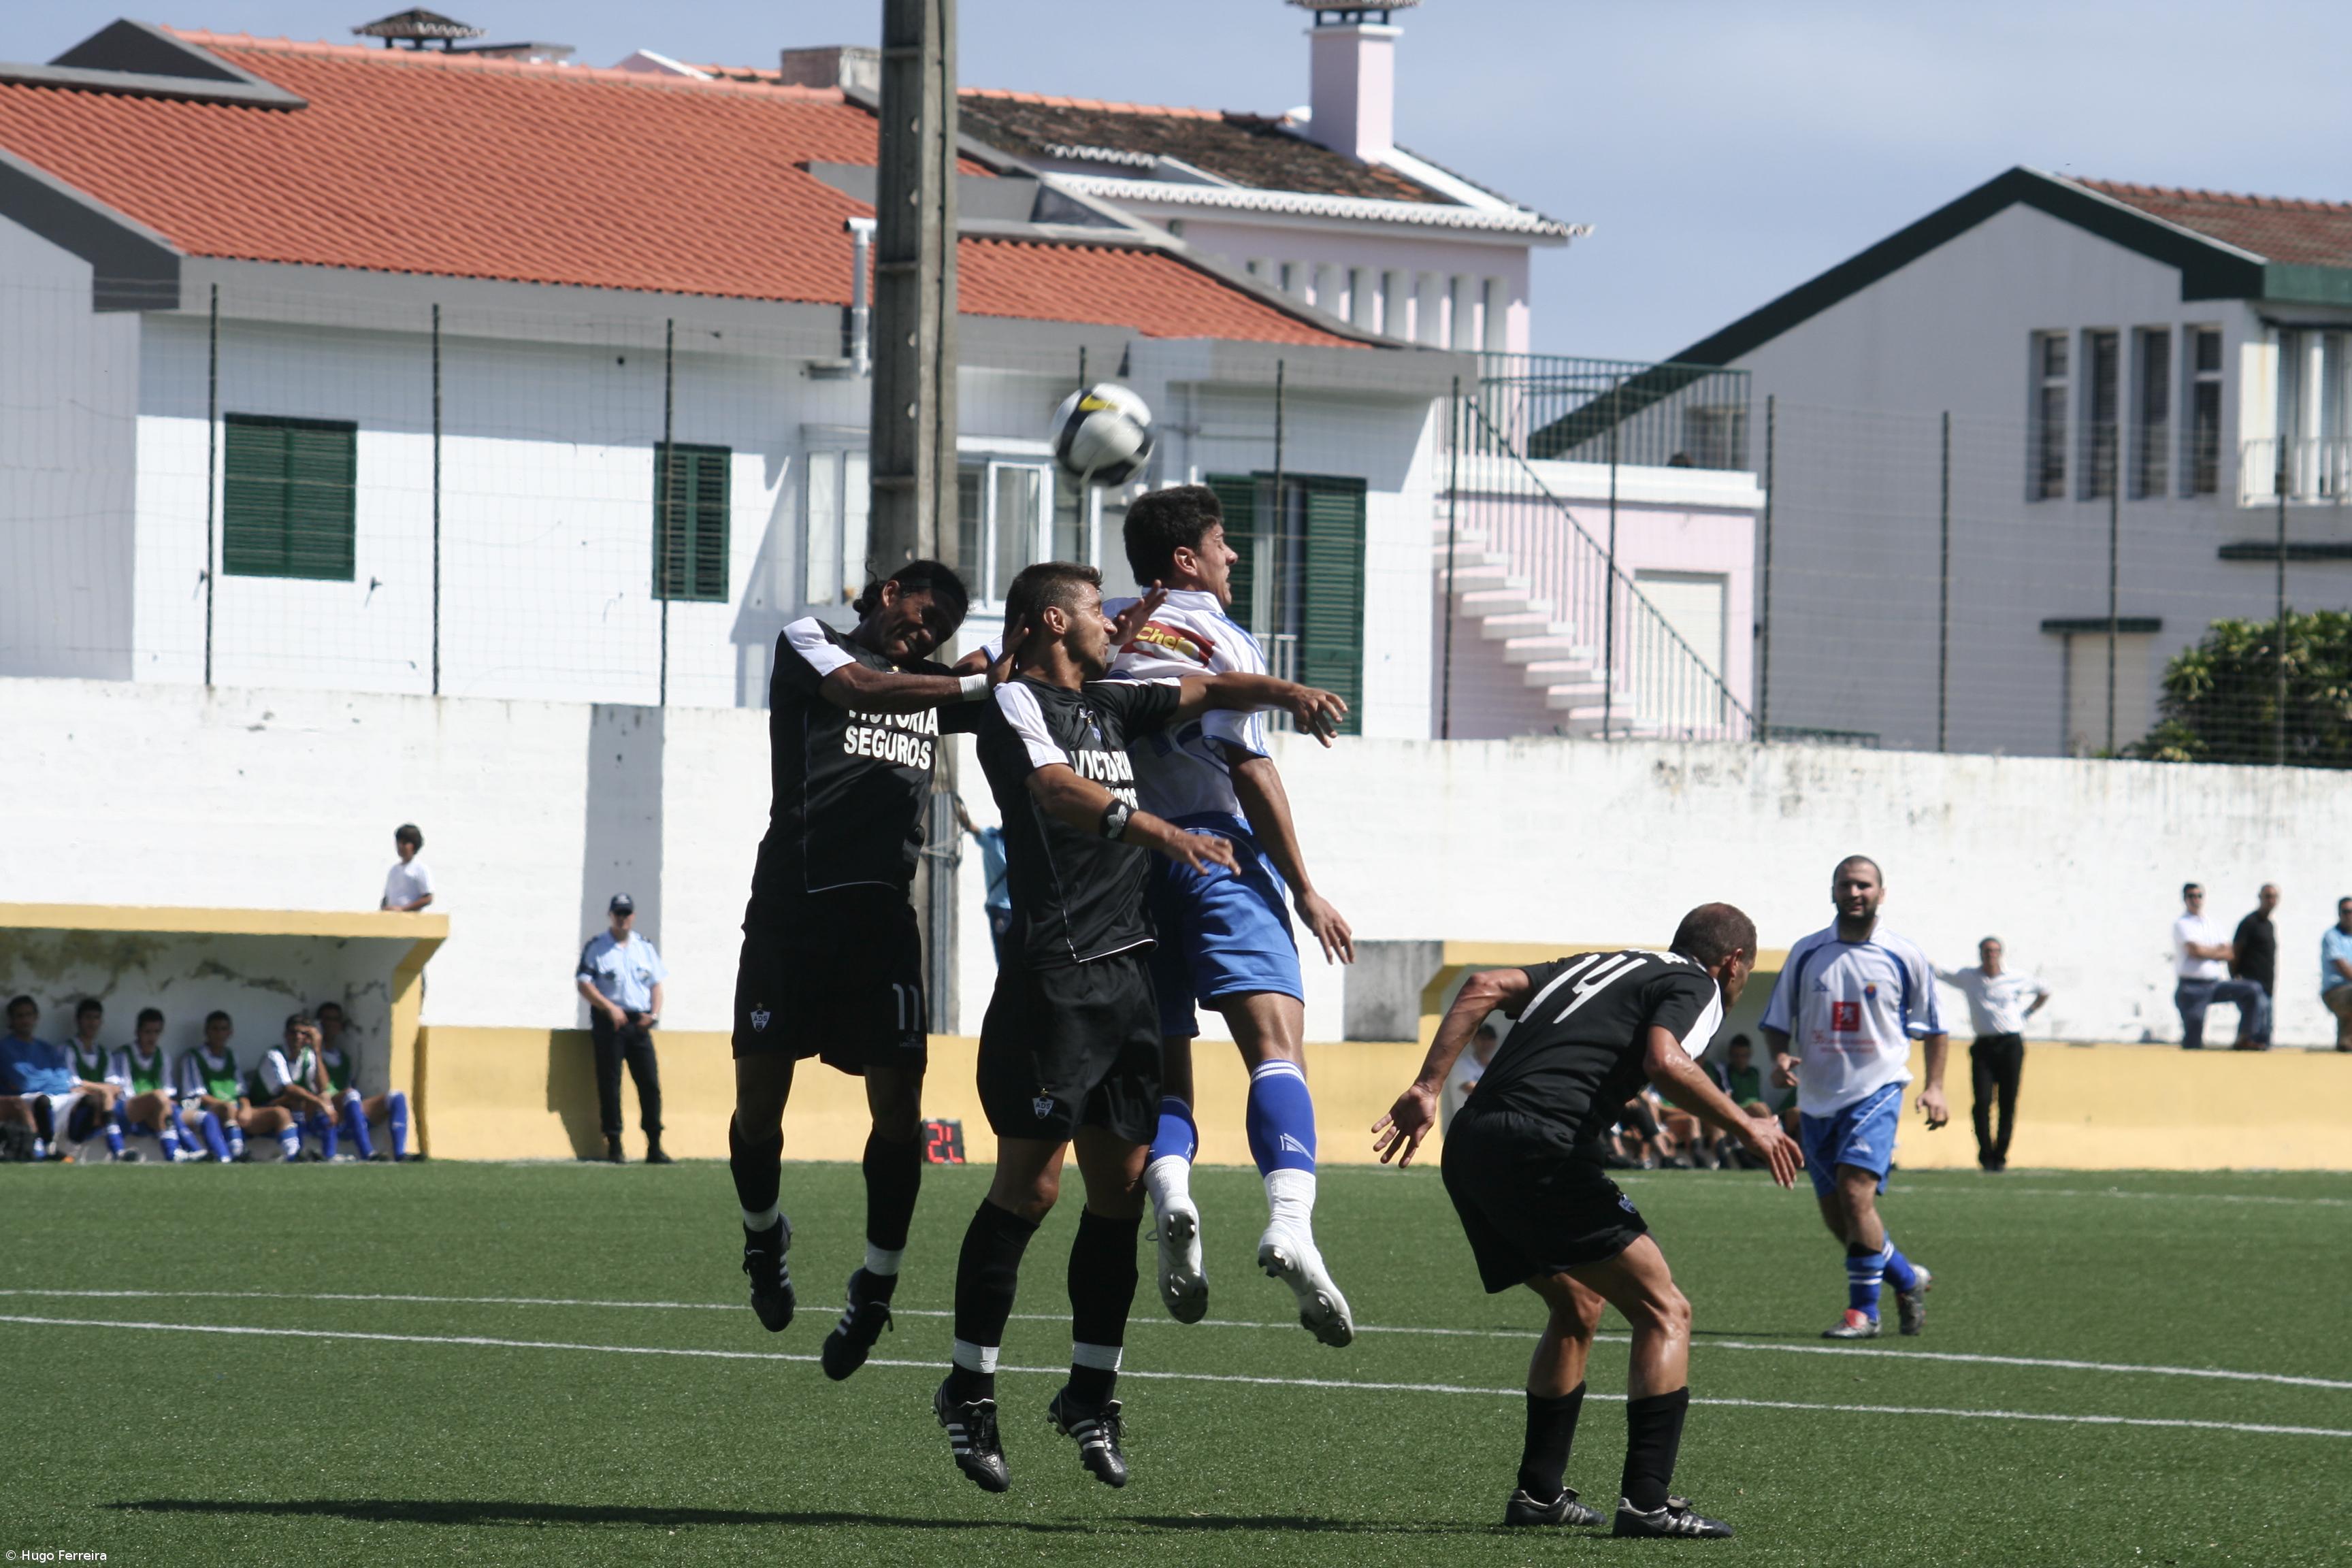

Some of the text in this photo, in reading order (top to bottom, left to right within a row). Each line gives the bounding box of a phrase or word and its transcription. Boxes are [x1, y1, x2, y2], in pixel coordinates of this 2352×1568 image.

[844, 725, 932, 770] SEGUROS
[892, 983, 919, 1032] 11
[1518, 953, 1648, 1024] 14
